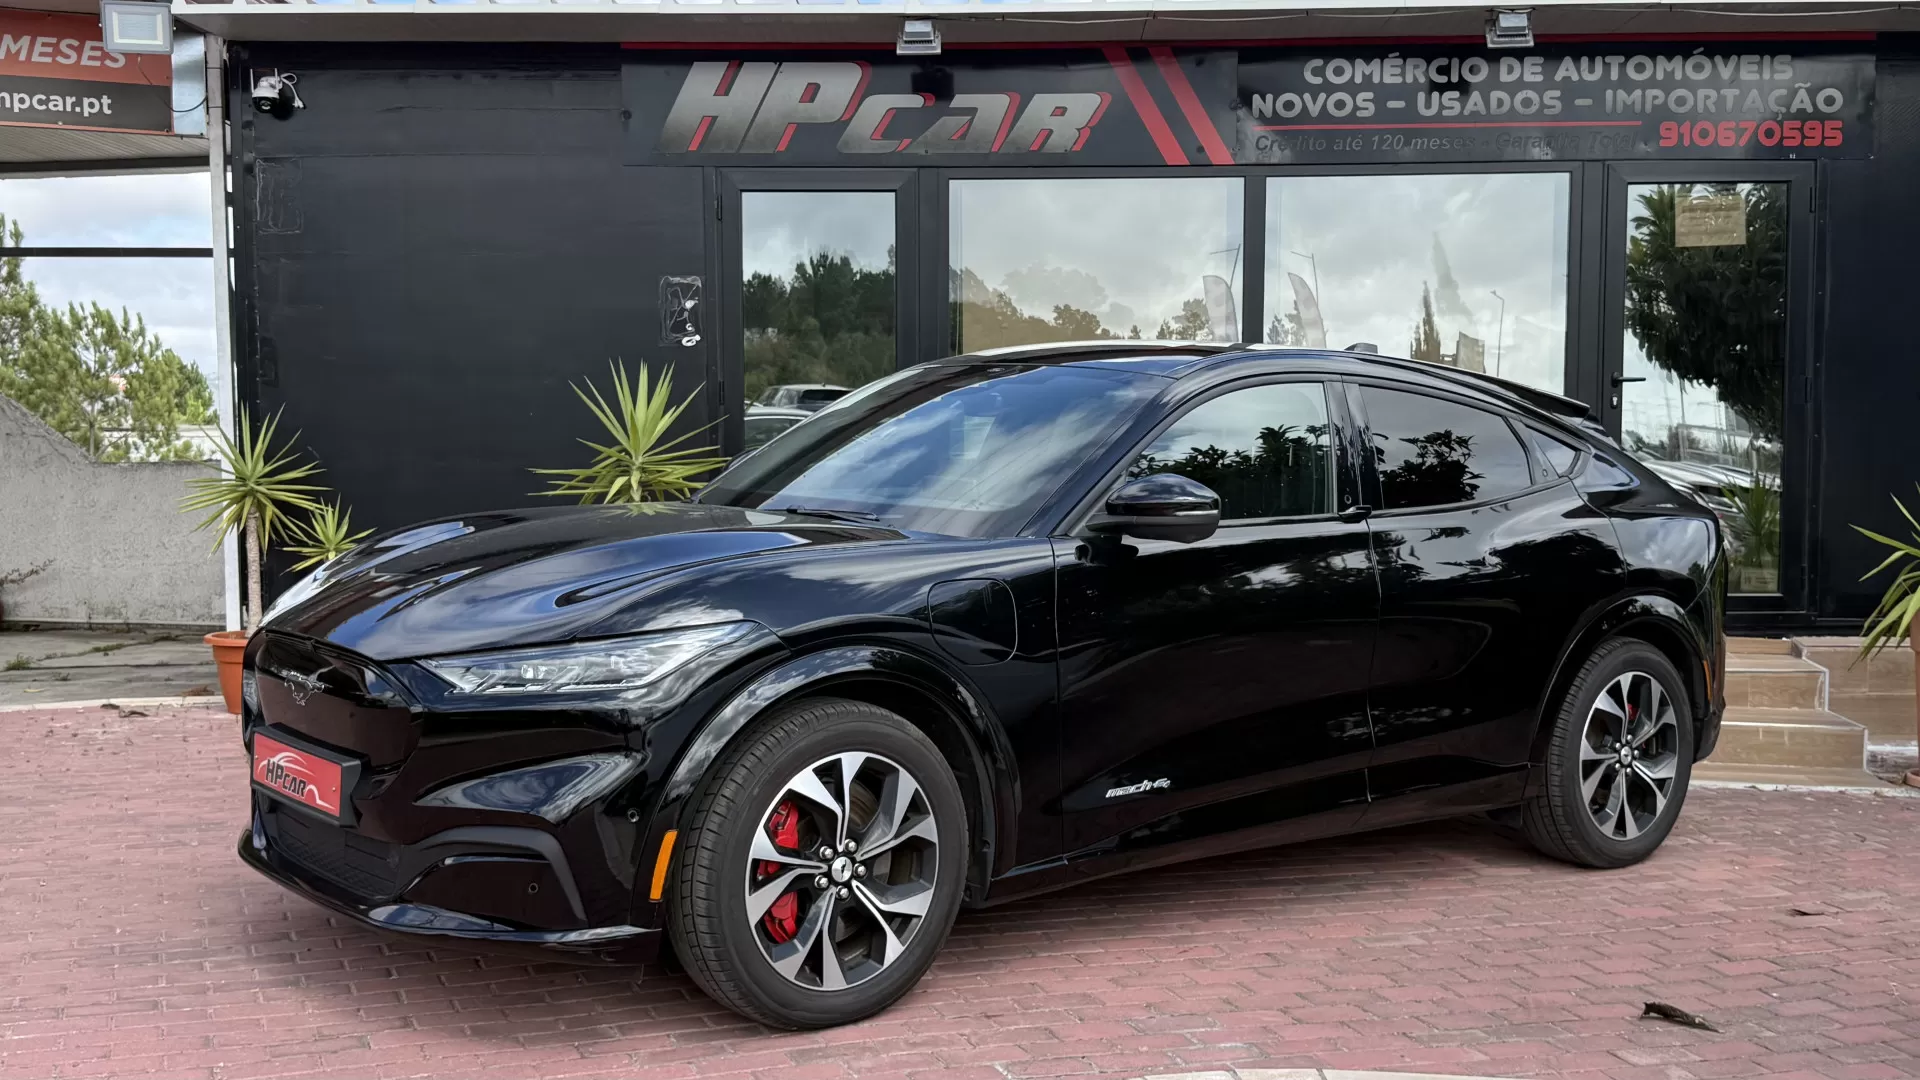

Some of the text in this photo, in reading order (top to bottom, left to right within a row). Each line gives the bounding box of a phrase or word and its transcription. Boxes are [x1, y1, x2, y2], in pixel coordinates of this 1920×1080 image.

[0, 34, 126, 68] MESES
[1303, 47, 1793, 84] COMÉRCIO DE AUTOMÓVEIS
[1252, 92, 1376, 118] NOVOS
[1417, 90, 1562, 116] USADOS
[1605, 82, 1844, 120] IMPORTAÇÃO
[1333, 134, 1364, 151] até
[1371, 134, 1403, 150] 120
[1410, 137, 1476, 150] meses
[1658, 119, 1844, 147] 910670595
